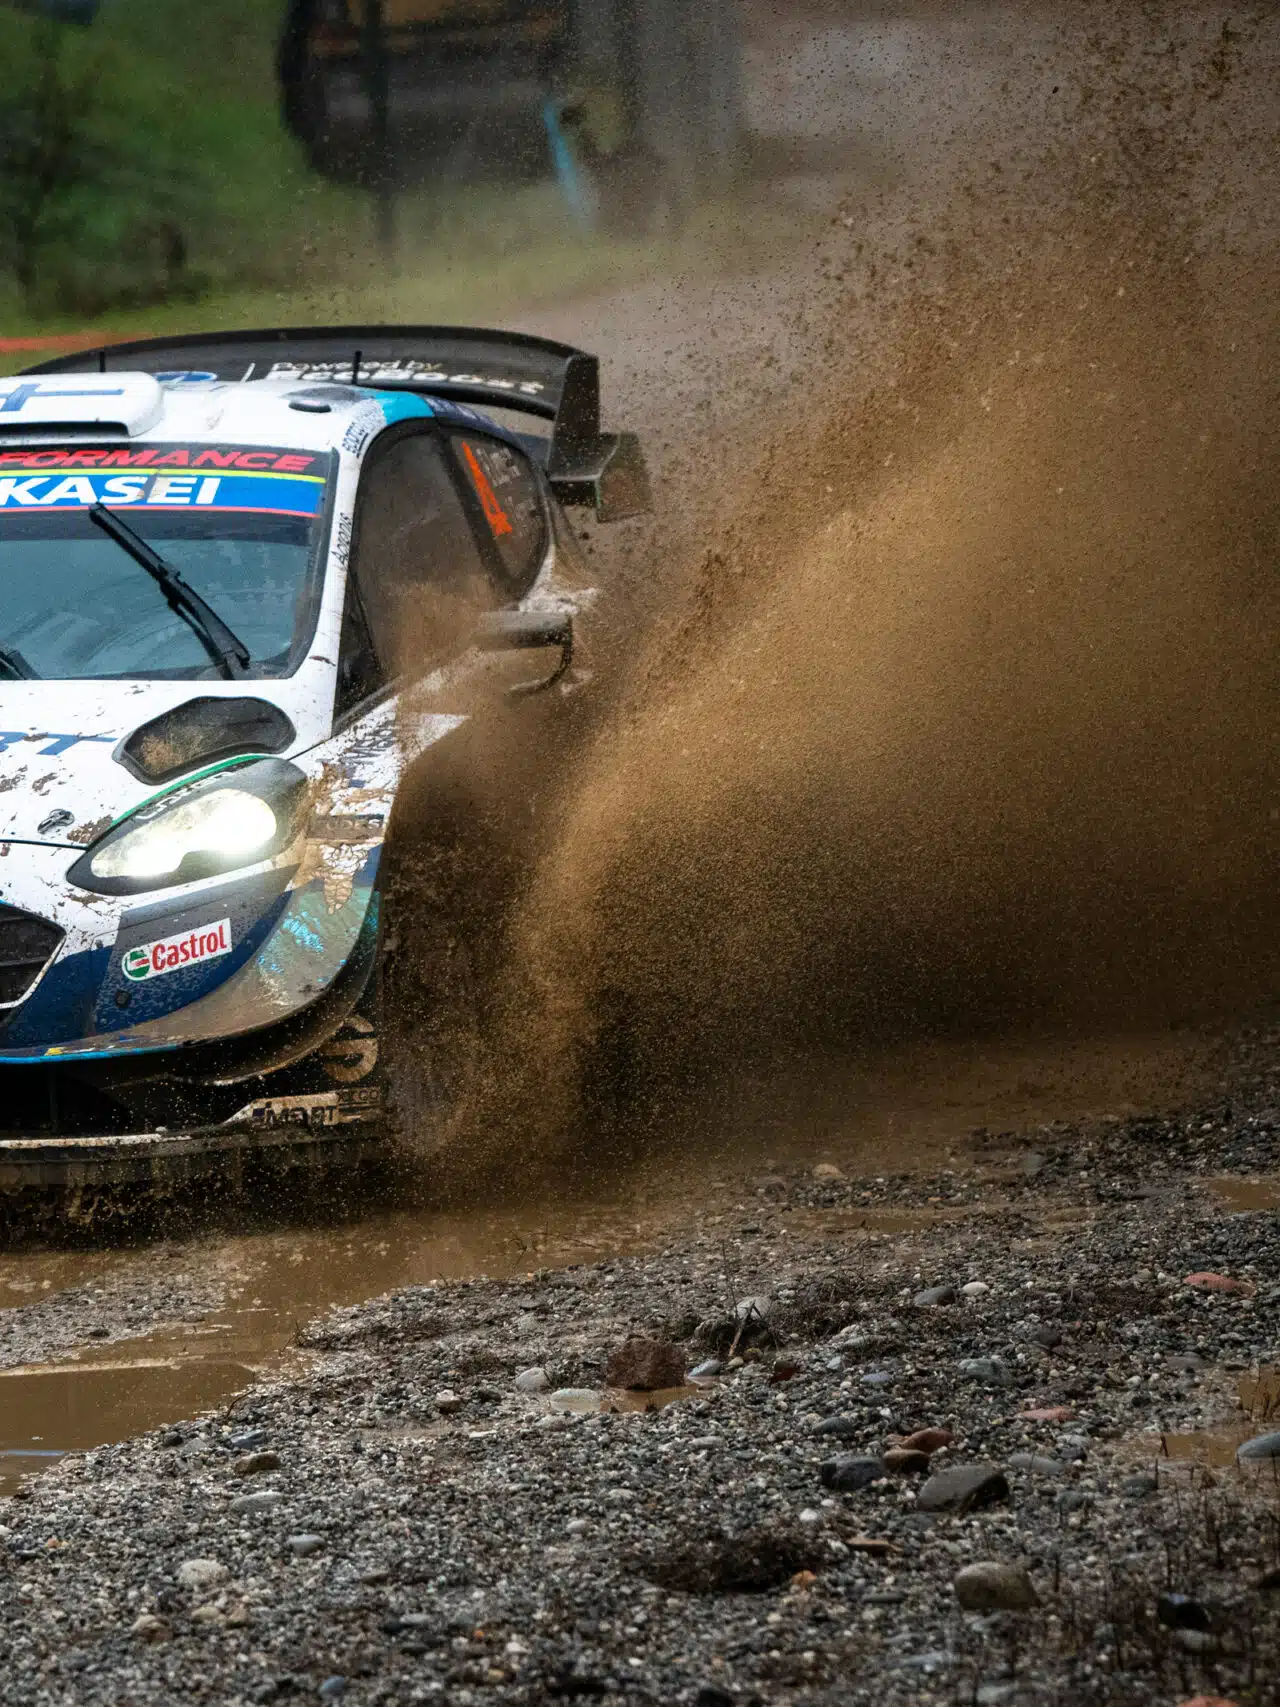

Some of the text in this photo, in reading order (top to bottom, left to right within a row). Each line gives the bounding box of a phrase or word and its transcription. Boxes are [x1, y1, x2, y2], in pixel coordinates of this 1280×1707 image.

[271, 359, 442, 371] Poweed by
[152, 925, 227, 970] Castrol
